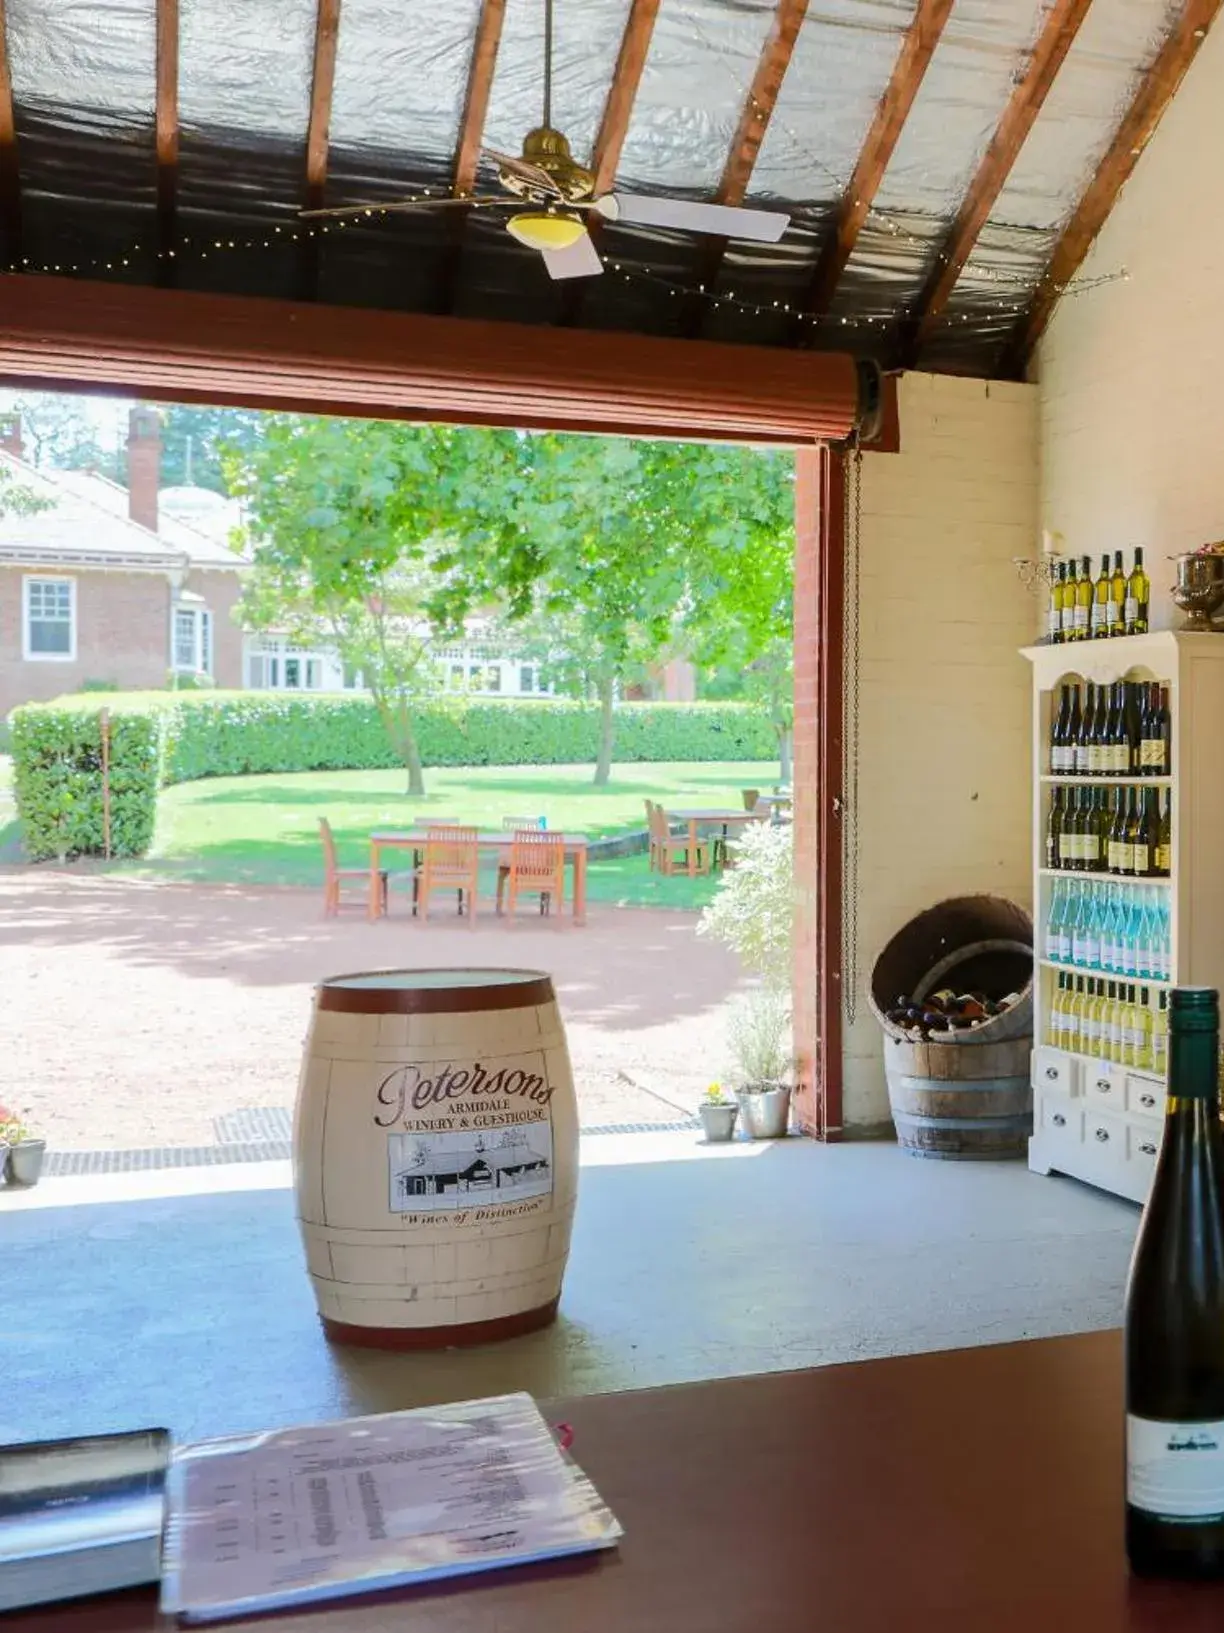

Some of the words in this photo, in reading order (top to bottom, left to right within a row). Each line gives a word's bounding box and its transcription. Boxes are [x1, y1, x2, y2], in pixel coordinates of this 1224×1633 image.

[373, 1063, 556, 1127] Petersons
[447, 1099, 510, 1114] ARMIDALE
[403, 1118, 455, 1131] WINERY
[459, 1119, 470, 1128] &
[473, 1109, 548, 1127] GUESTHOUSE
[453, 1212, 469, 1225] of
